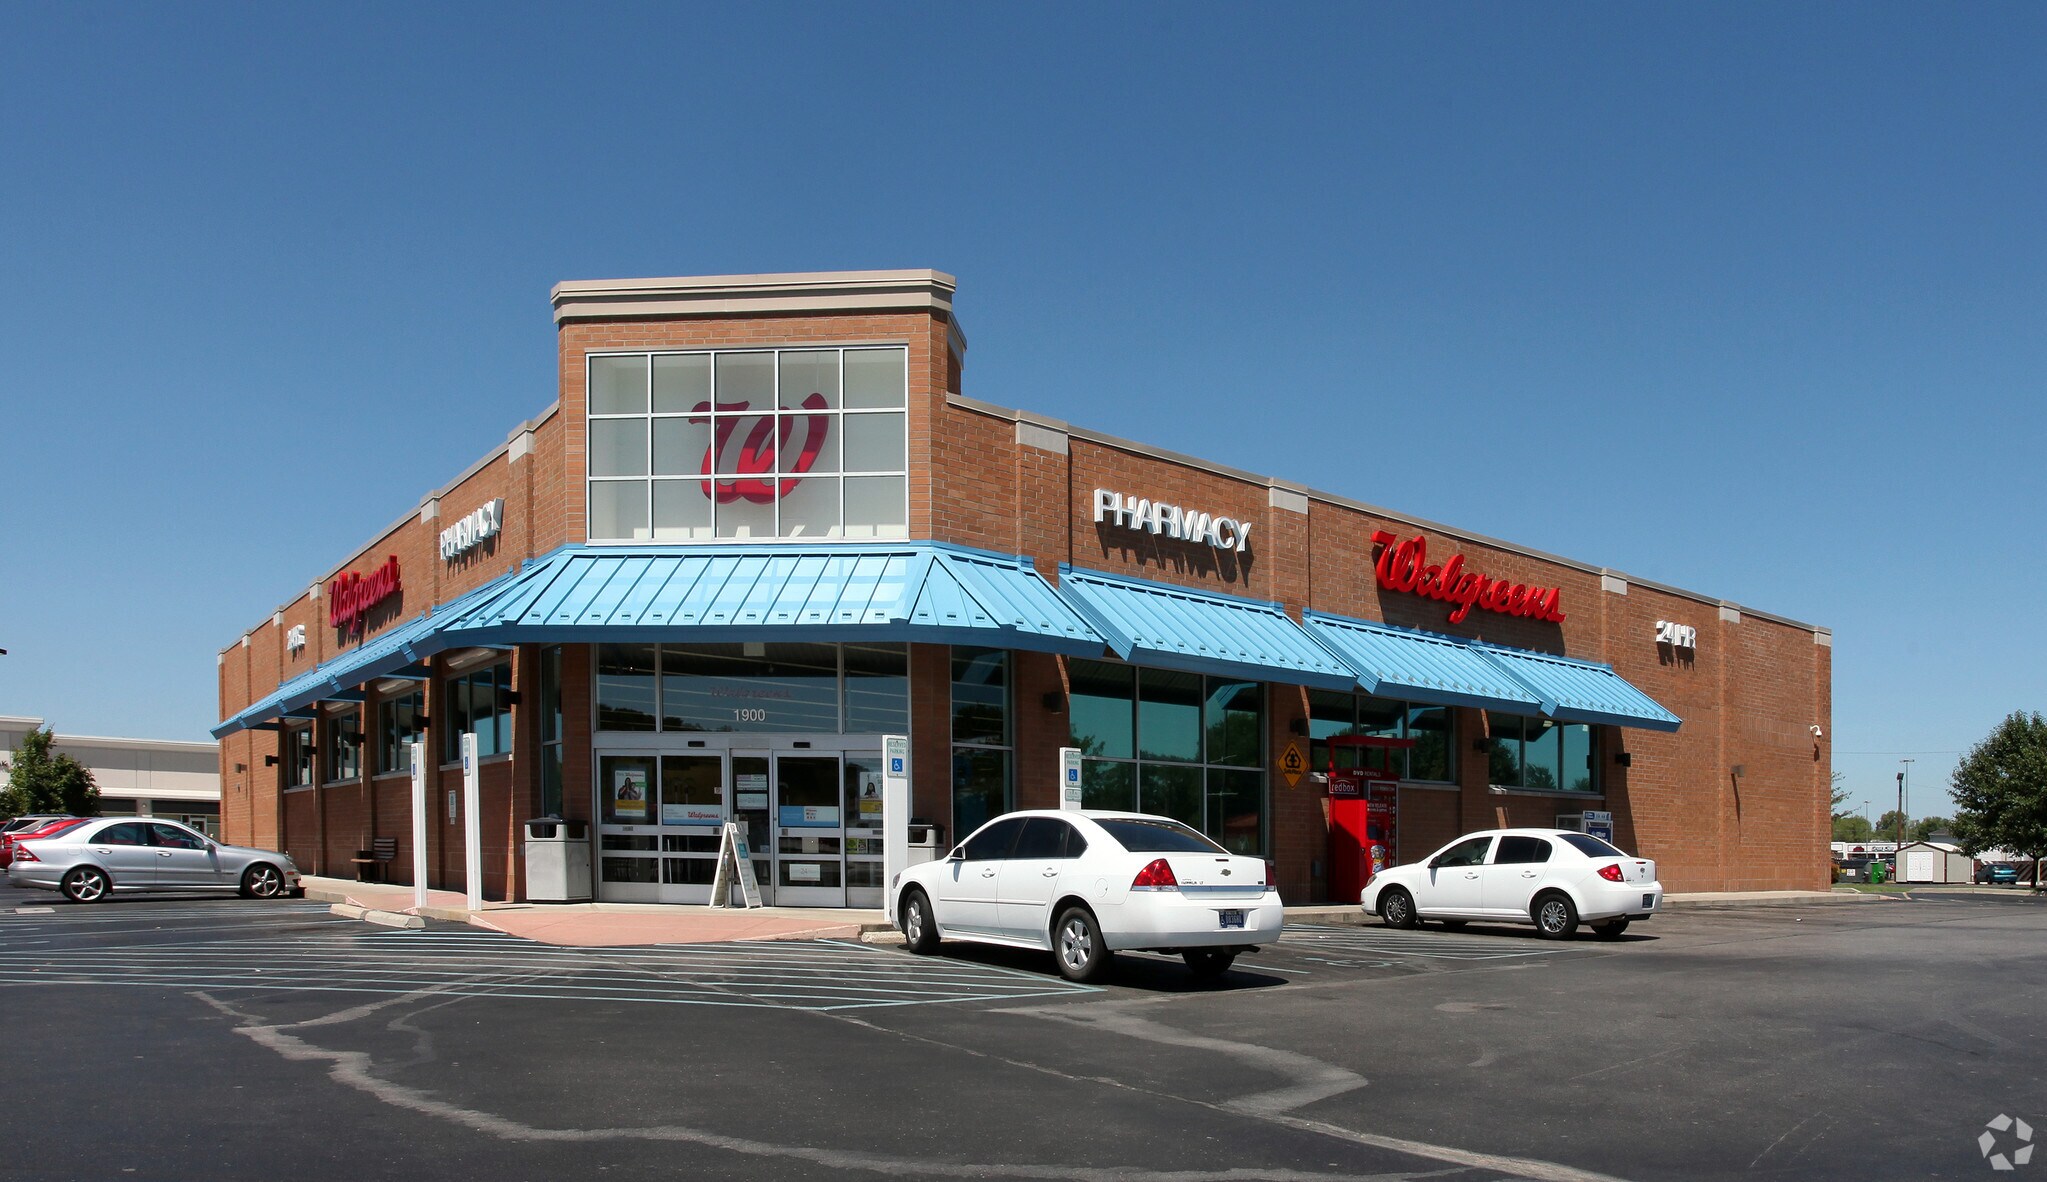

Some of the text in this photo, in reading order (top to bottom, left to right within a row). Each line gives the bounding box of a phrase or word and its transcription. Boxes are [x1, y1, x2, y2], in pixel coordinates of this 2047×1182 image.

[440, 498, 504, 560] PHARMACY
[1093, 488, 1252, 552] PHARMACY
[328, 554, 401, 636] Walgreens
[1371, 530, 1567, 625] Walgreens
[734, 709, 766, 721] 1900
[688, 811, 719, 820] Walgreens
[1331, 782, 1355, 792] redbox
